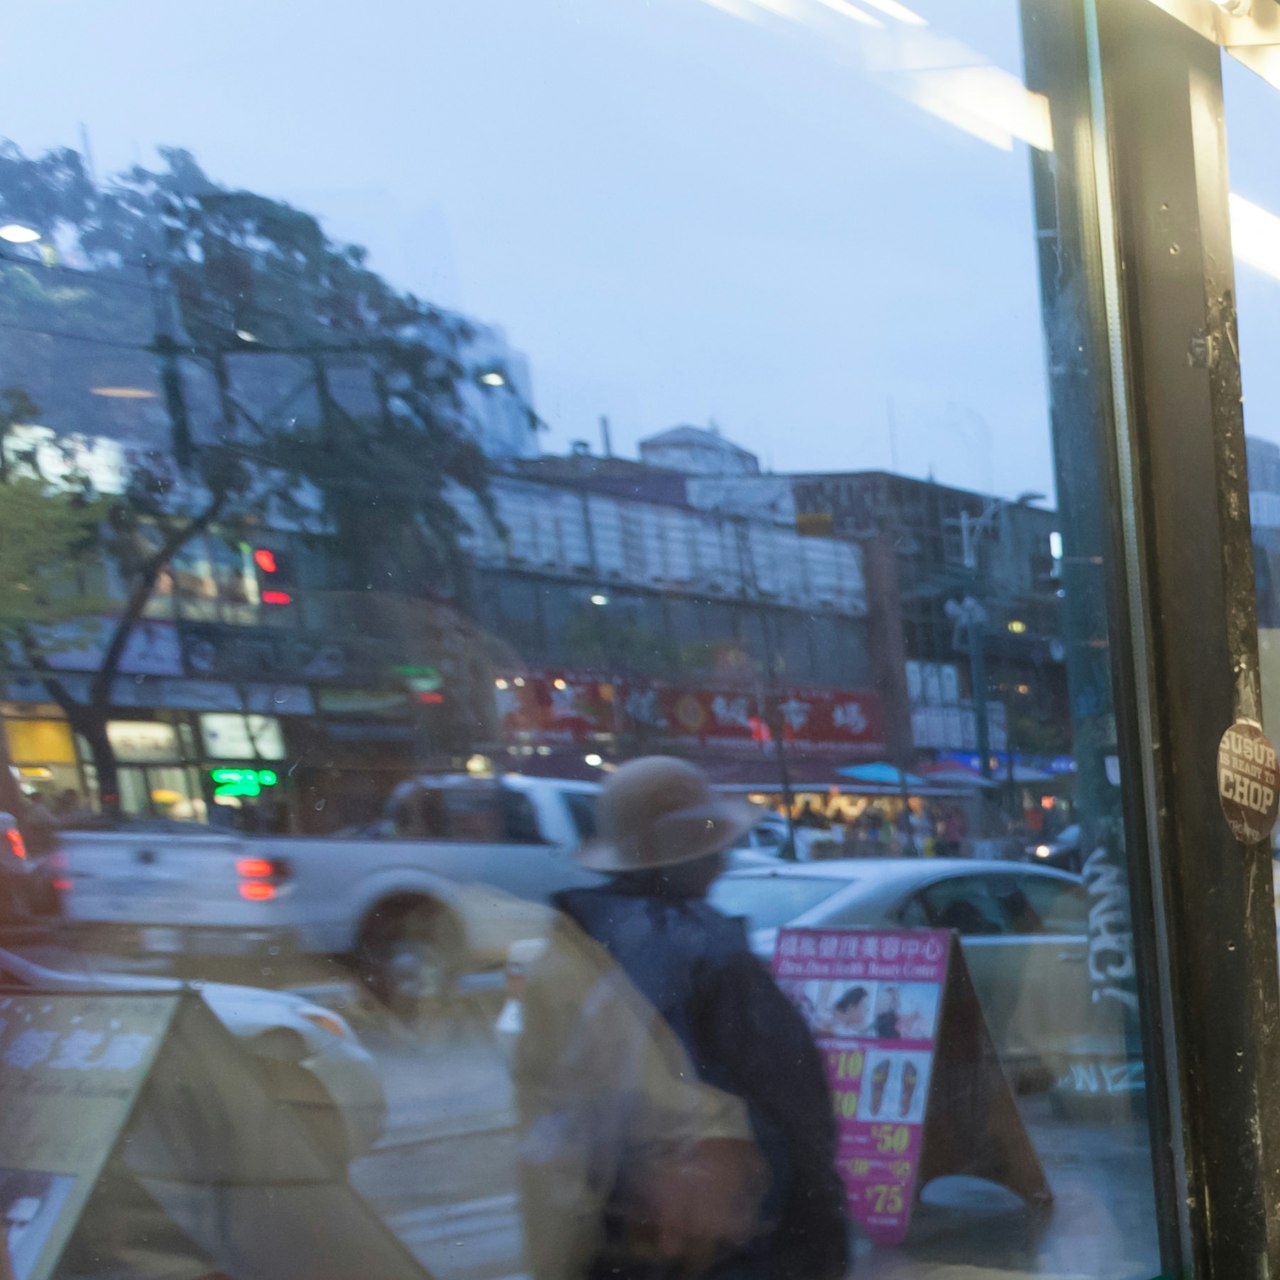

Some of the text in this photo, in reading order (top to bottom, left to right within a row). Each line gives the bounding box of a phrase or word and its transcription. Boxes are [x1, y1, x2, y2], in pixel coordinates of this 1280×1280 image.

[1220, 731, 1276, 770] SUSUR
[1219, 752, 1276, 785] IS READY TO
[1220, 768, 1274, 815] CHOP
[871, 1124, 910, 1153] $50
[865, 1184, 904, 1214] $75
